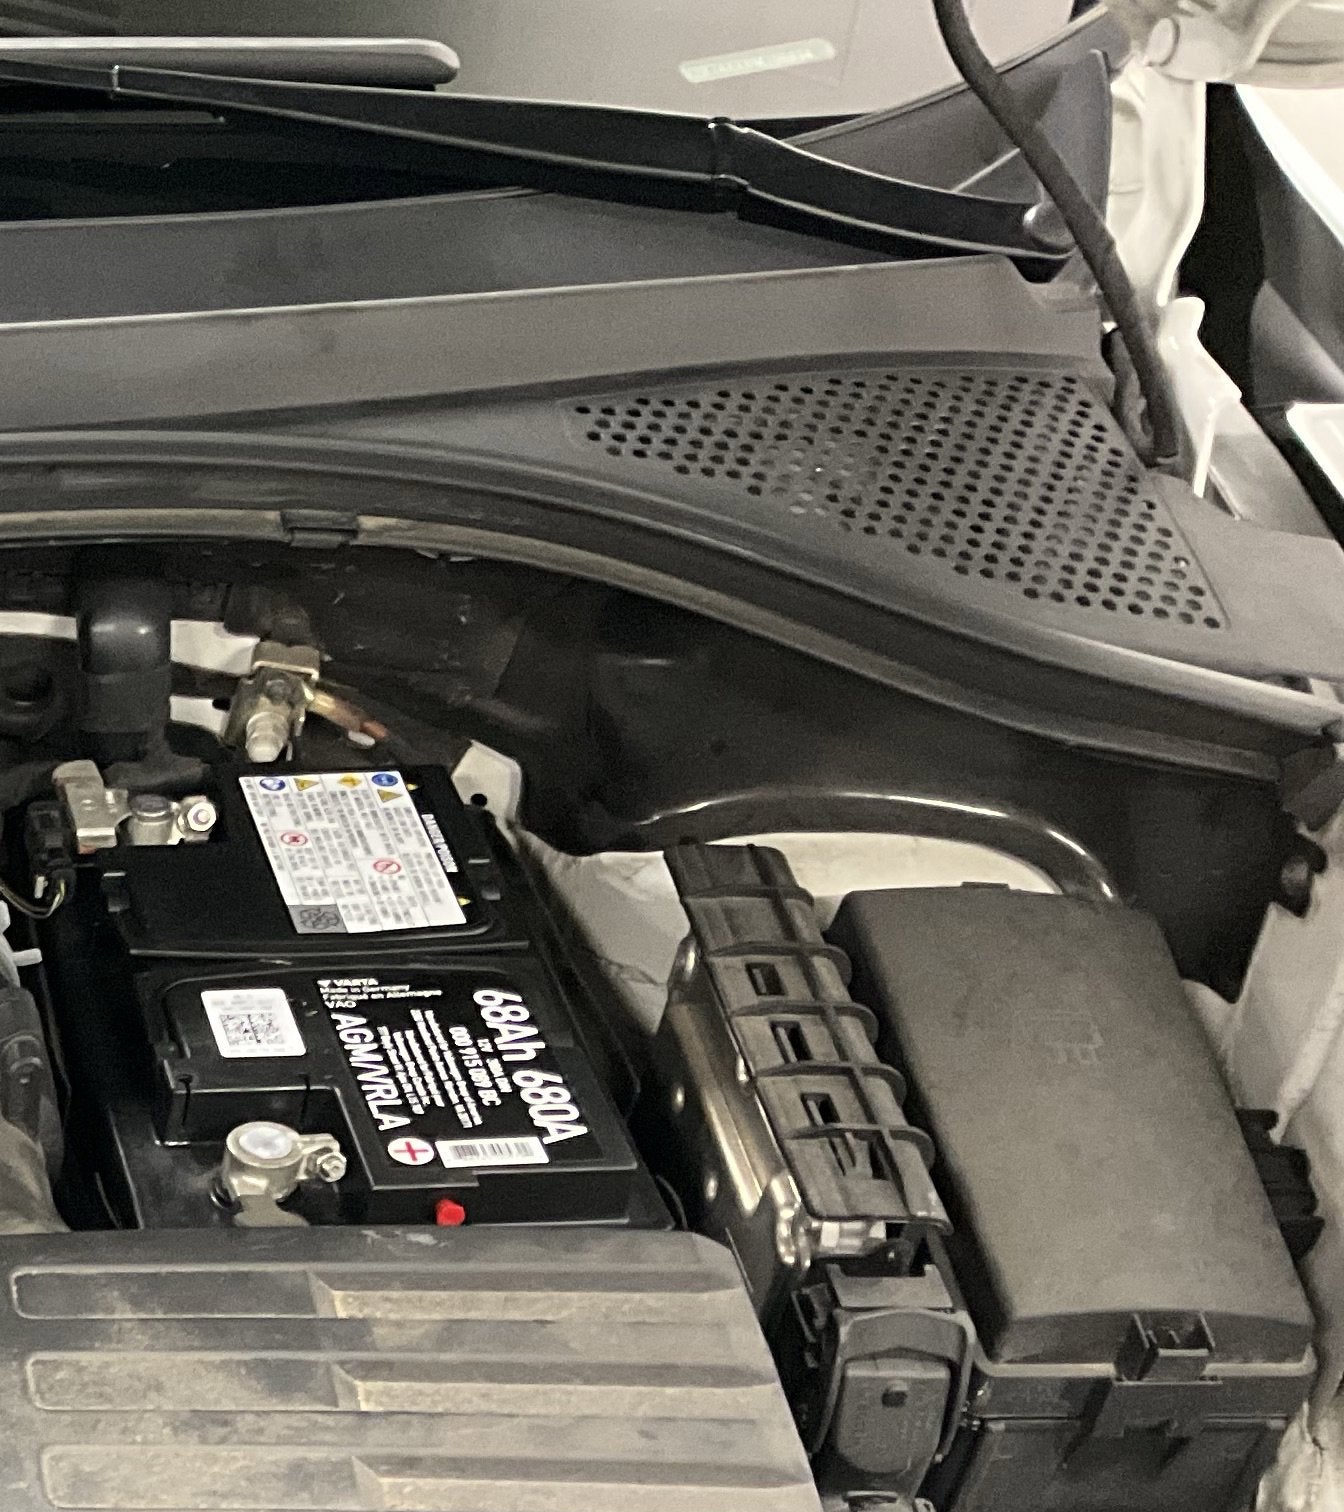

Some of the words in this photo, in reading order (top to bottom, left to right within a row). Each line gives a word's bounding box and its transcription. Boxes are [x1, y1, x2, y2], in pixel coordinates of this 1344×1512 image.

[333, 978, 379, 987] VARTA
[319, 986, 349, 994] Made
[362, 984, 410, 993] Germany
[371, 991, 384, 999] en
[330, 1012, 411, 1131] AGM/VRLA
[472, 989, 546, 1062] 68Ah
[511, 1069, 588, 1144] 680A
